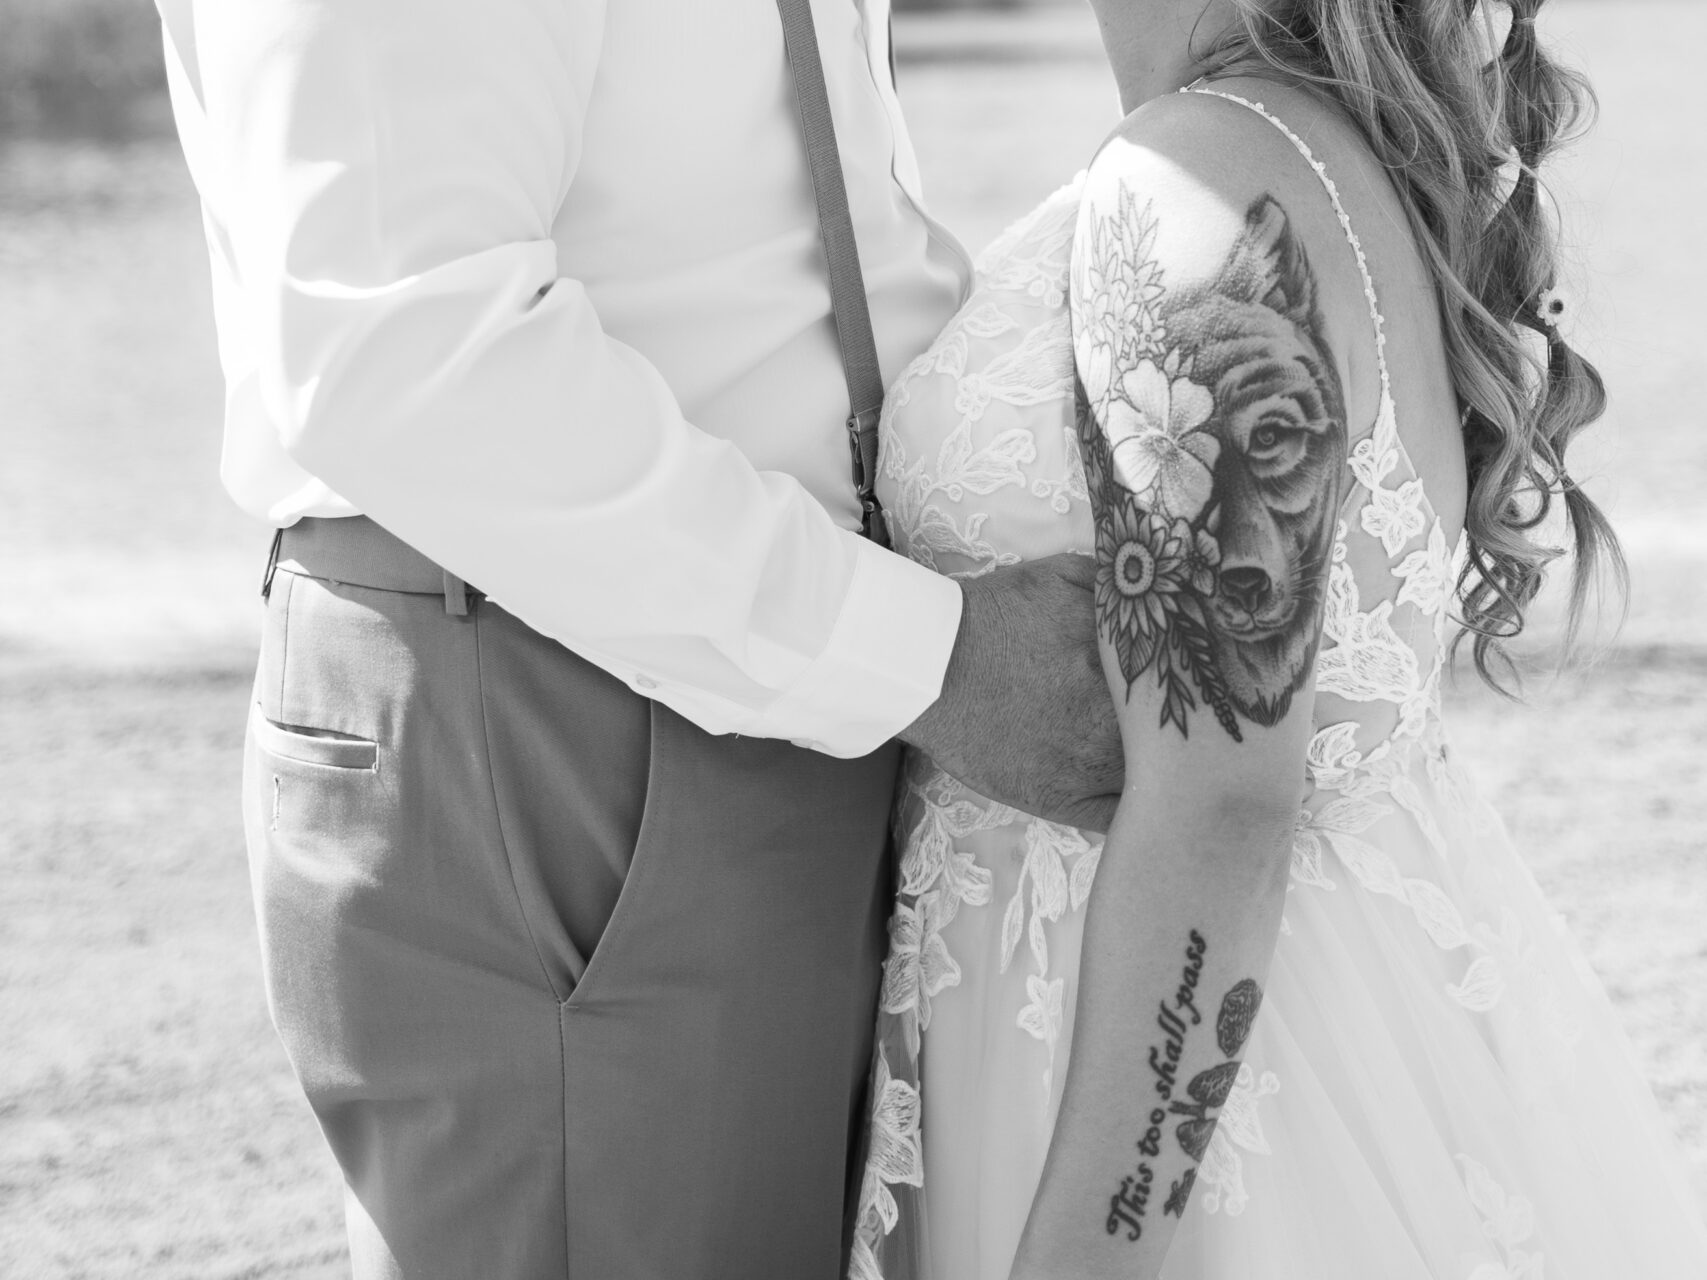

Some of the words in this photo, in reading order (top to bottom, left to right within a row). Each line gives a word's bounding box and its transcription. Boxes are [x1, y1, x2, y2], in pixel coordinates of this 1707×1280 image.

[1175, 928, 1207, 1025] pass
[1149, 1000, 1187, 1101] shall
[1137, 1108, 1166, 1157] too
[1106, 1162, 1153, 1242] This
